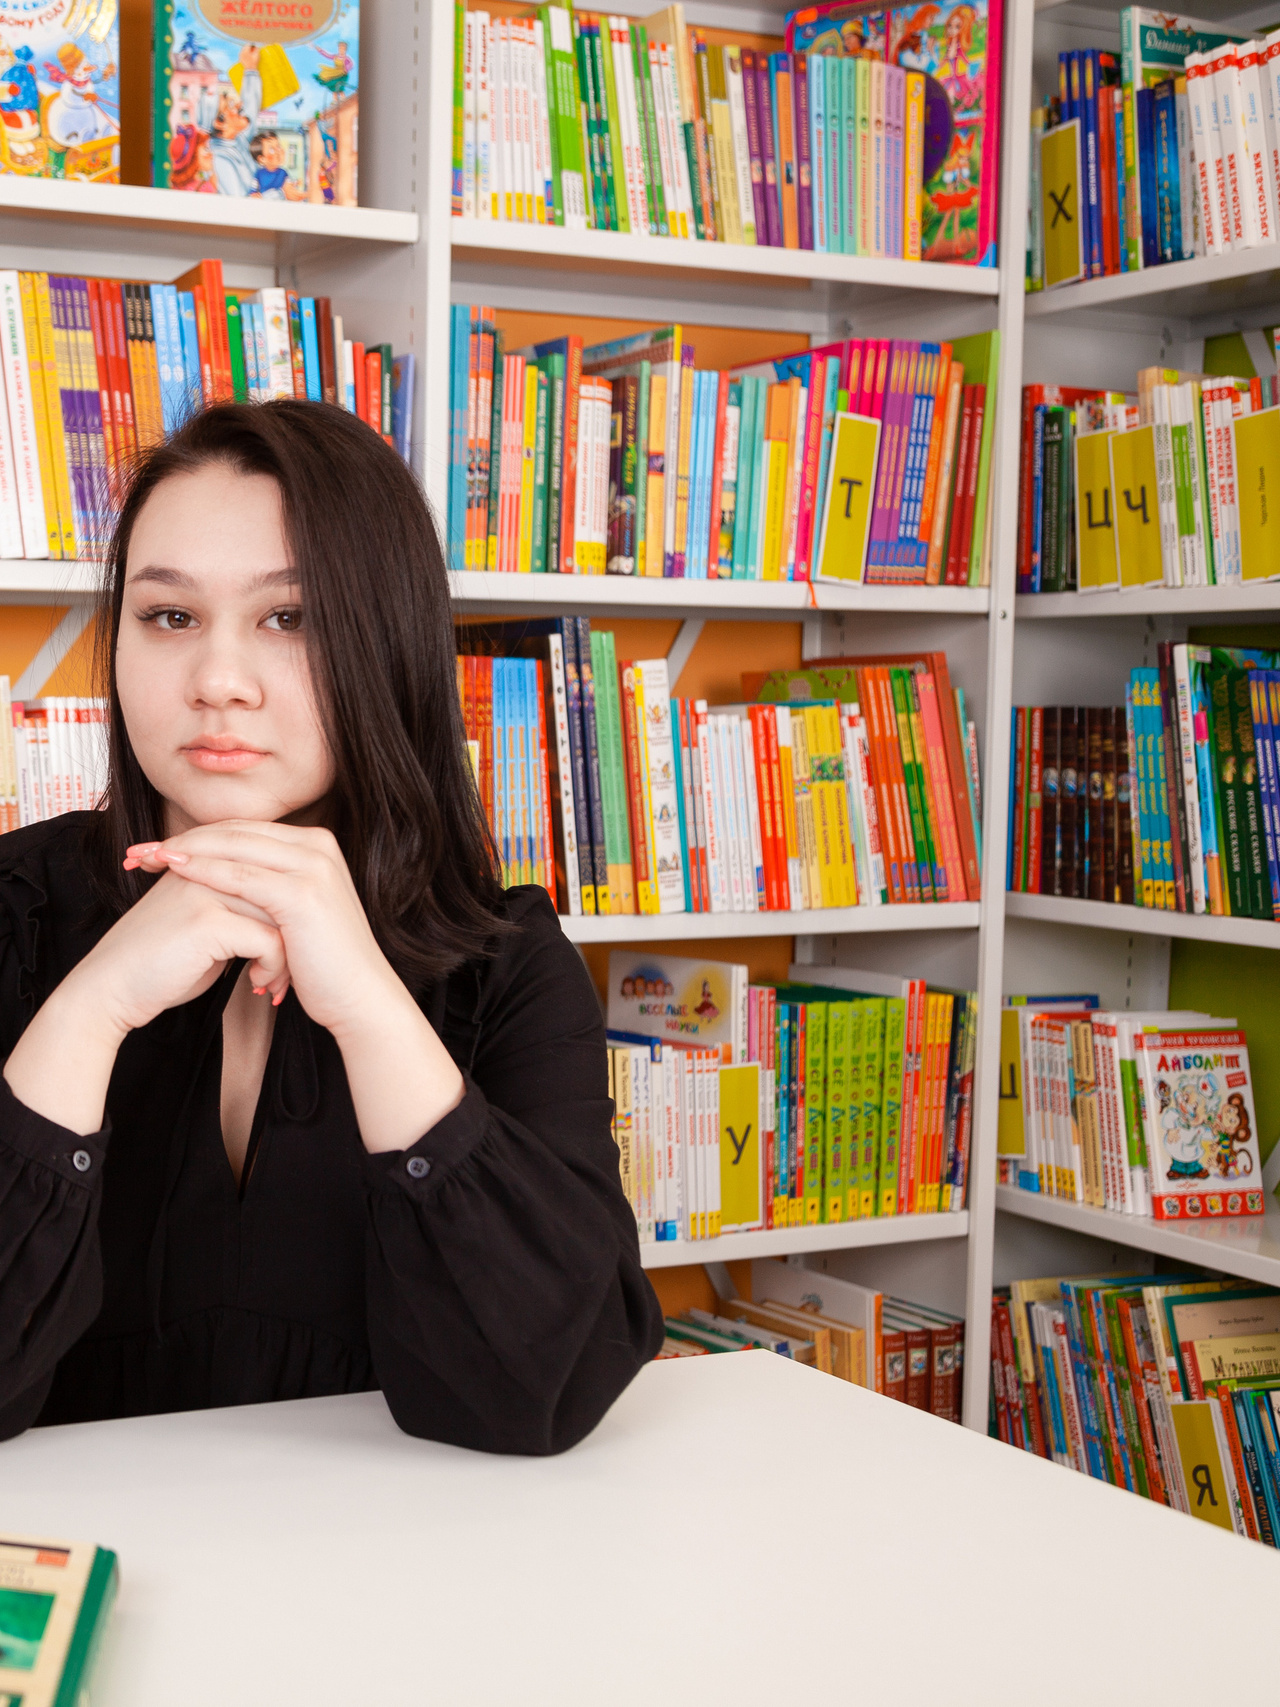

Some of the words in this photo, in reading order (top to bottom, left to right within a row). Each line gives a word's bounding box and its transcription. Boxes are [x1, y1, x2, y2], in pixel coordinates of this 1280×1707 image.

[1049, 183, 1072, 230] Х
[839, 476, 863, 519] Т
[1085, 486, 1112, 529] Ц
[1123, 484, 1150, 524] Ч
[1156, 1053, 1241, 1073] АЙБОЛИТ
[621, 1136, 630, 1175] ДЕТЯМ
[726, 1123, 752, 1166] У
[1192, 1464, 1219, 1507] Я
